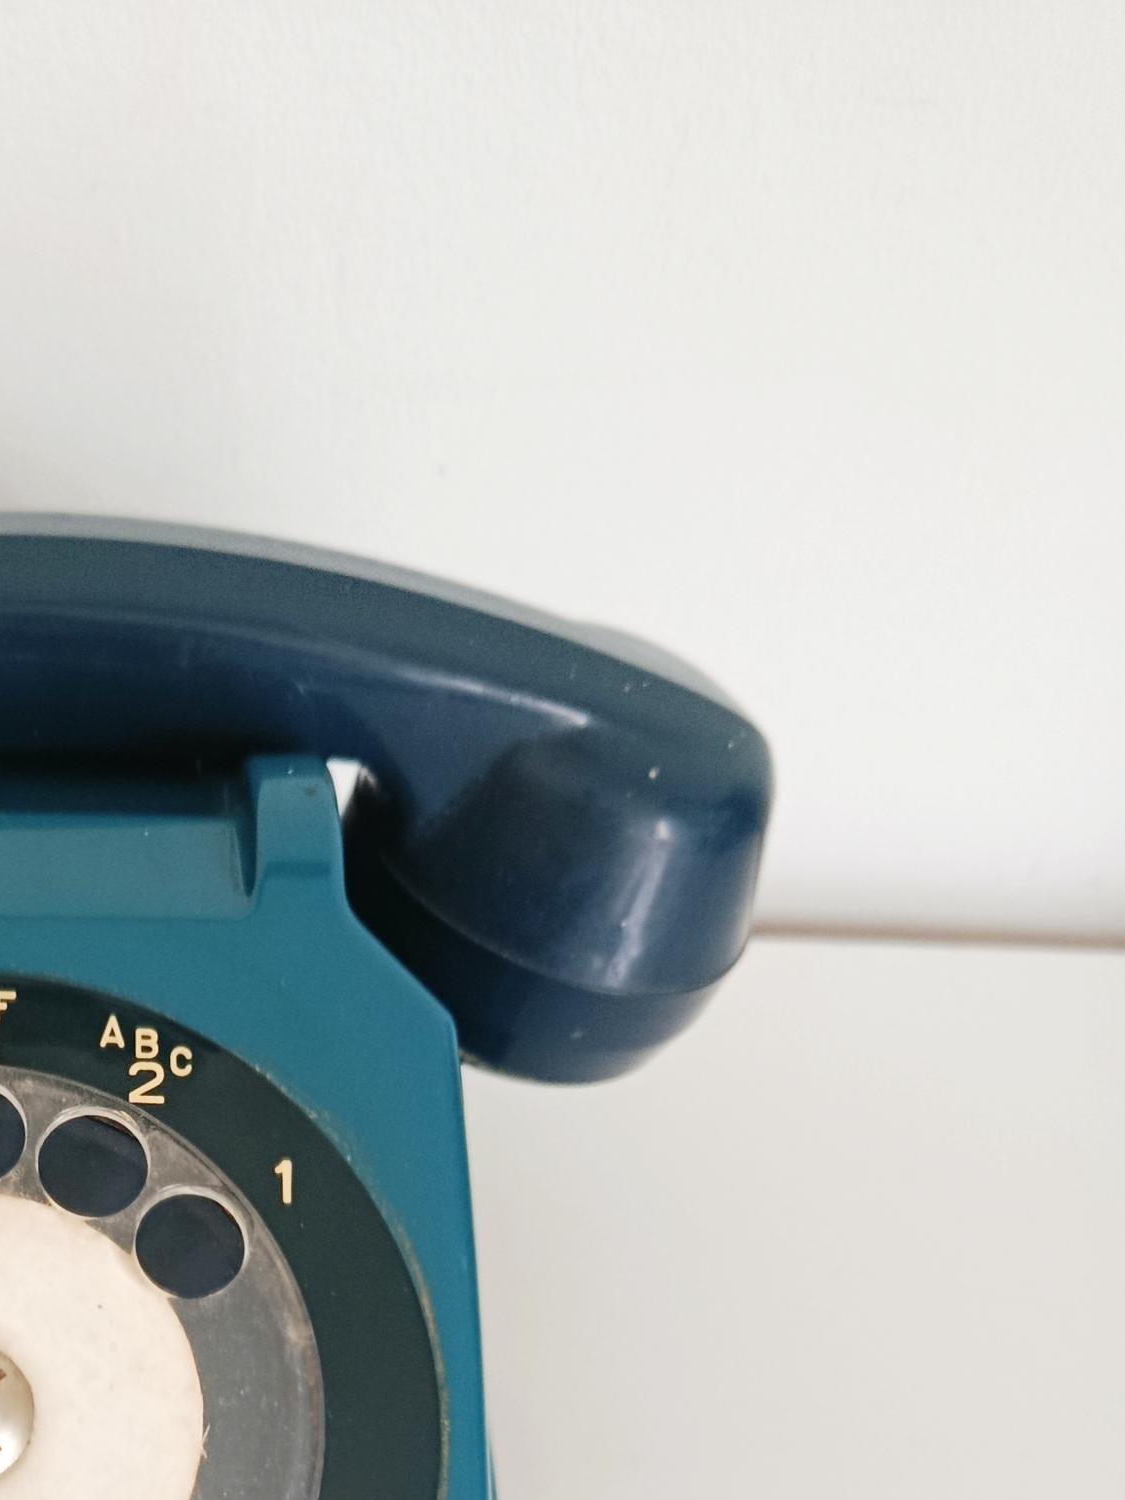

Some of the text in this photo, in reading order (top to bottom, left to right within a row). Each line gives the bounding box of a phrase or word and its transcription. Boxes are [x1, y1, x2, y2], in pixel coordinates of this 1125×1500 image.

[99, 1014, 193, 1077] ABC
[128, 1061, 165, 1105] 2
[274, 1159, 293, 1205] 1
